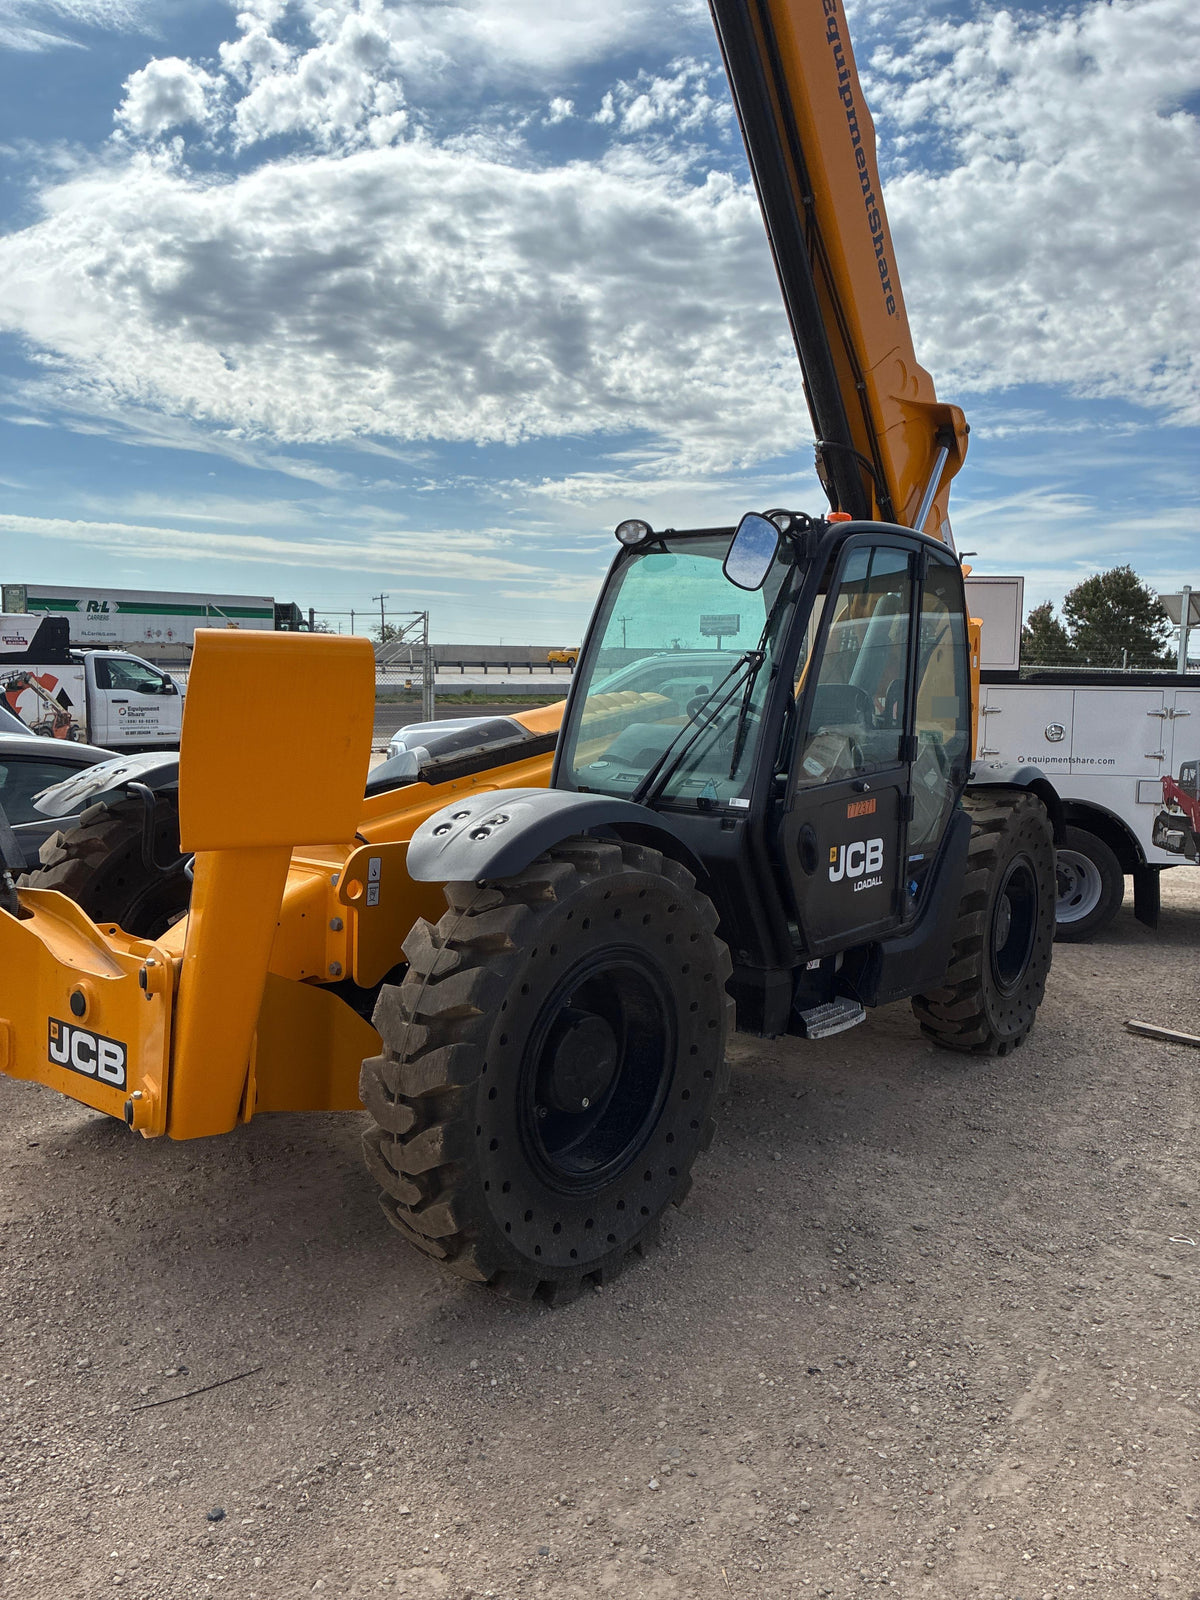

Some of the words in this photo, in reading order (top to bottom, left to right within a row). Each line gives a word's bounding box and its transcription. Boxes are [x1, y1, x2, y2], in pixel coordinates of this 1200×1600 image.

[1027, 755, 1116, 765] equipmentshare.com
[828, 837, 884, 883] JCB
[853, 875, 883, 892] LOADALL
[50, 1026, 125, 1086] JCB
